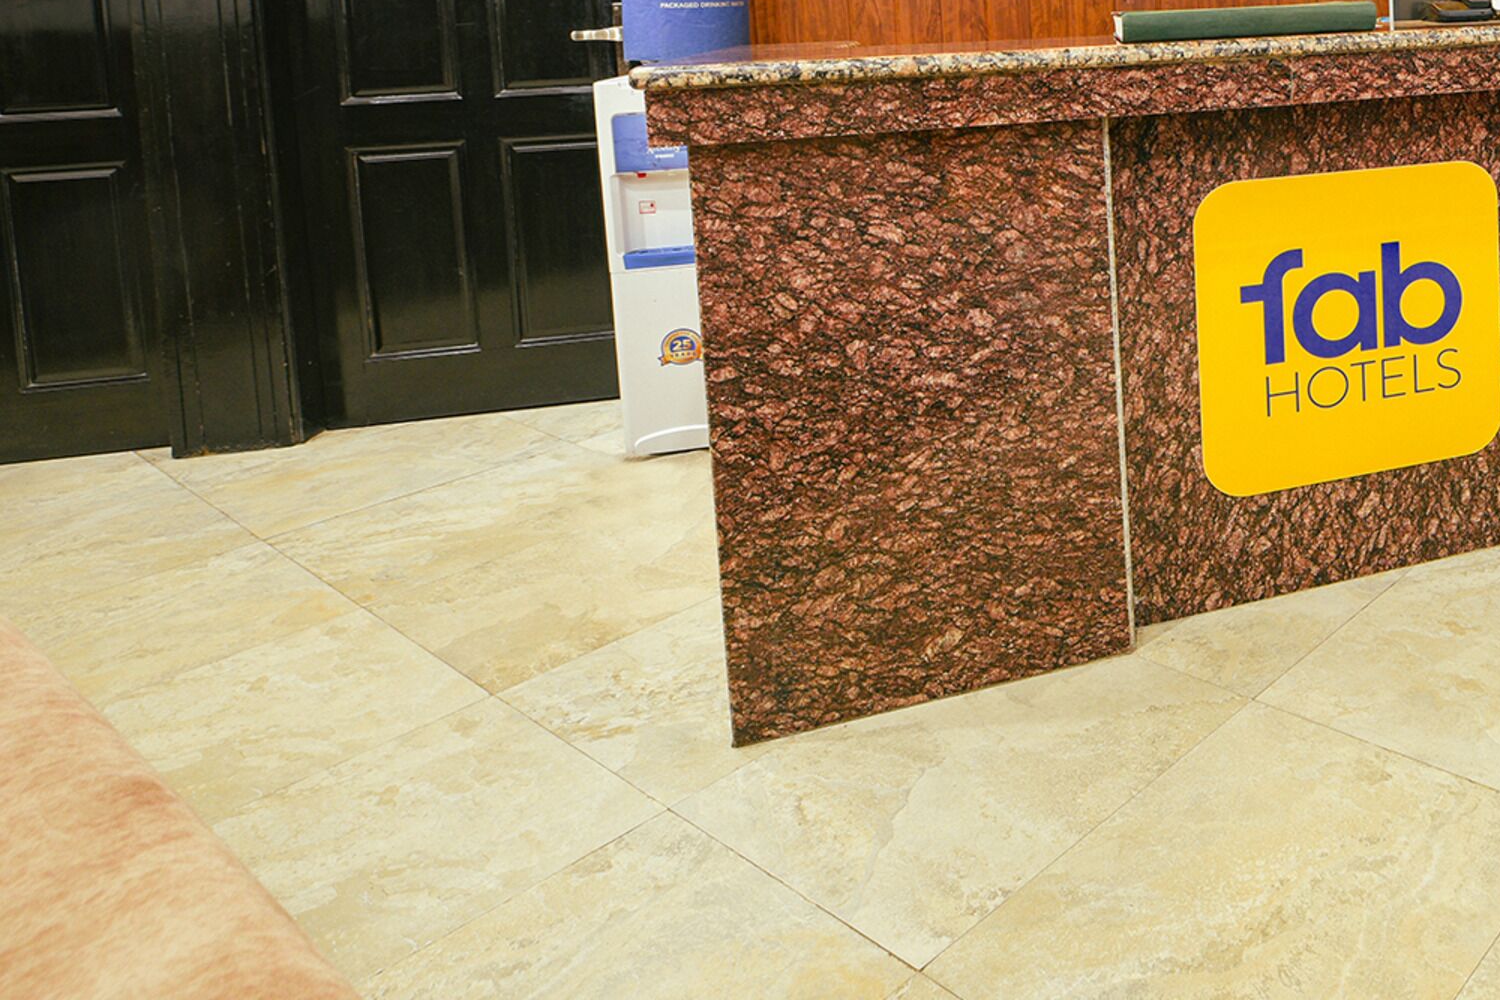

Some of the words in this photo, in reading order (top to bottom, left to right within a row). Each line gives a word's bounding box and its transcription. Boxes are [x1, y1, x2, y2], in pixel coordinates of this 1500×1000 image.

[660, 1, 699, 9] PACKAGED
[1240, 241, 1463, 366] fab
[672, 339, 693, 351] 25
[1265, 347, 1462, 418] HOTELS
